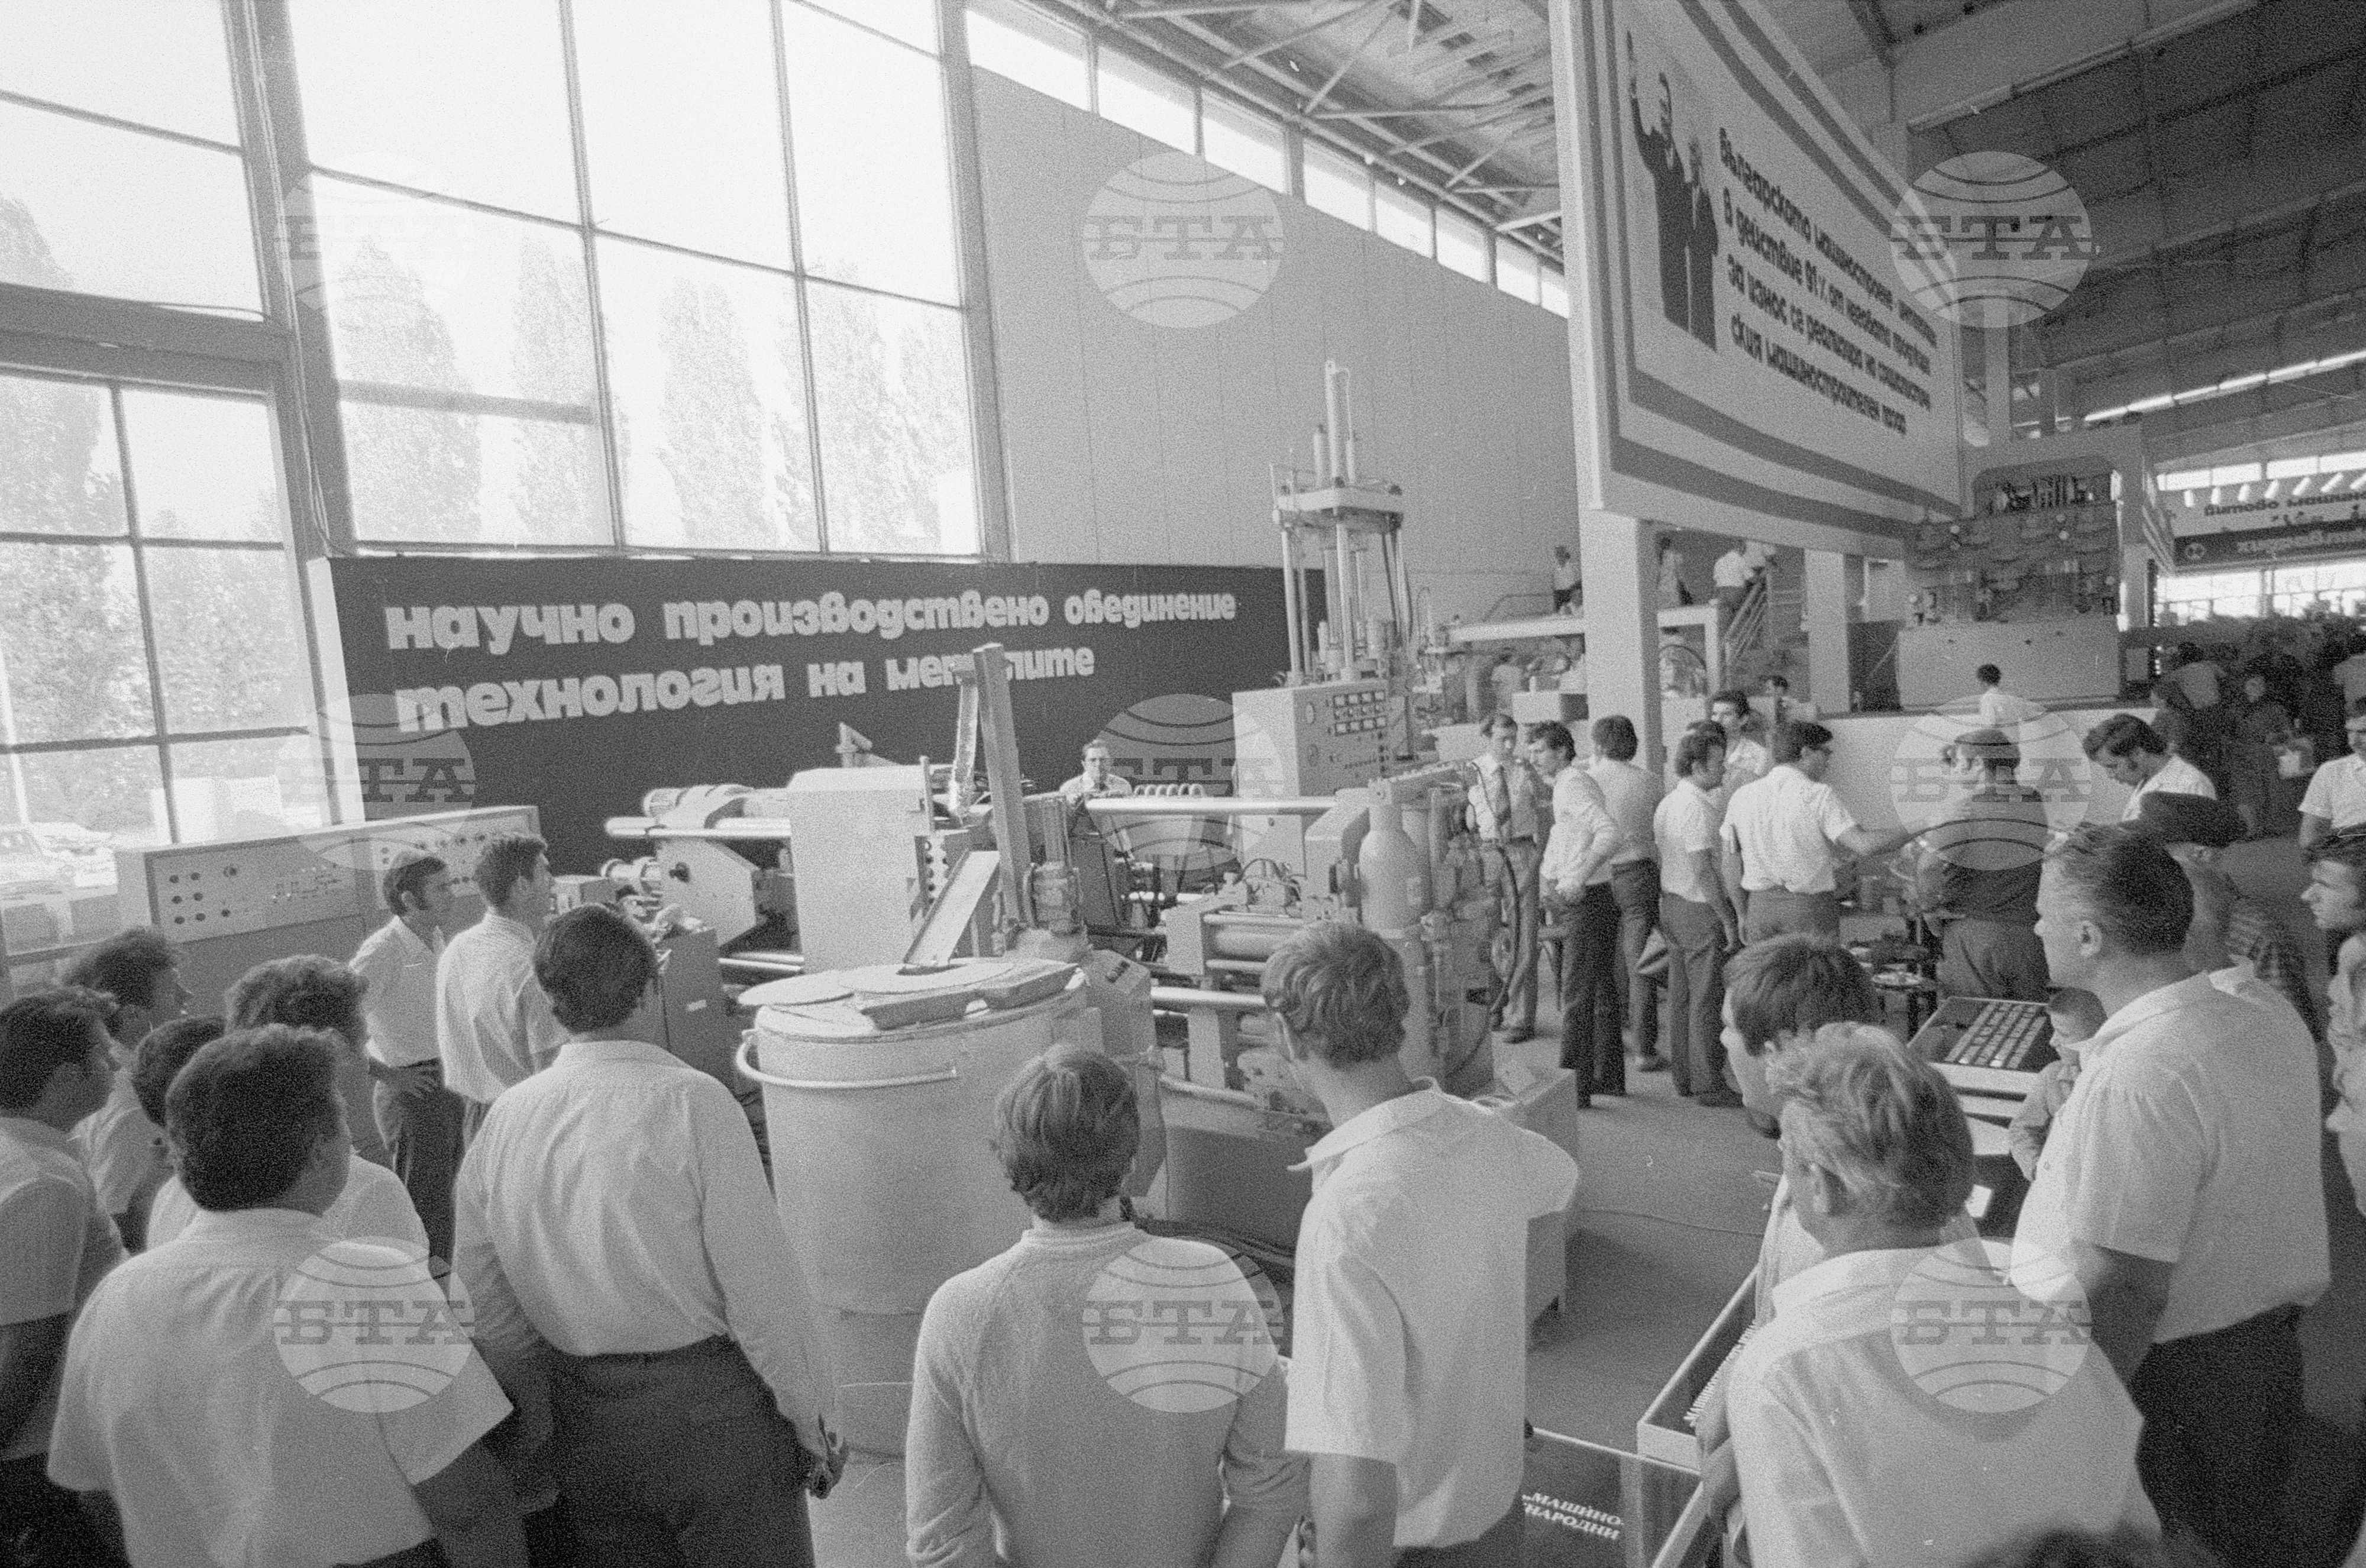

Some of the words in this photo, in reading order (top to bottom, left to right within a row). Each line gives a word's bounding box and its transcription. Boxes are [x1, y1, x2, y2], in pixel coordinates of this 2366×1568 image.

[384, 603, 636, 655] научно
[663, 590, 1049, 646] производствено
[1064, 589, 1236, 629] обединение
[395, 664, 786, 733] технология
[807, 661, 867, 698] на
